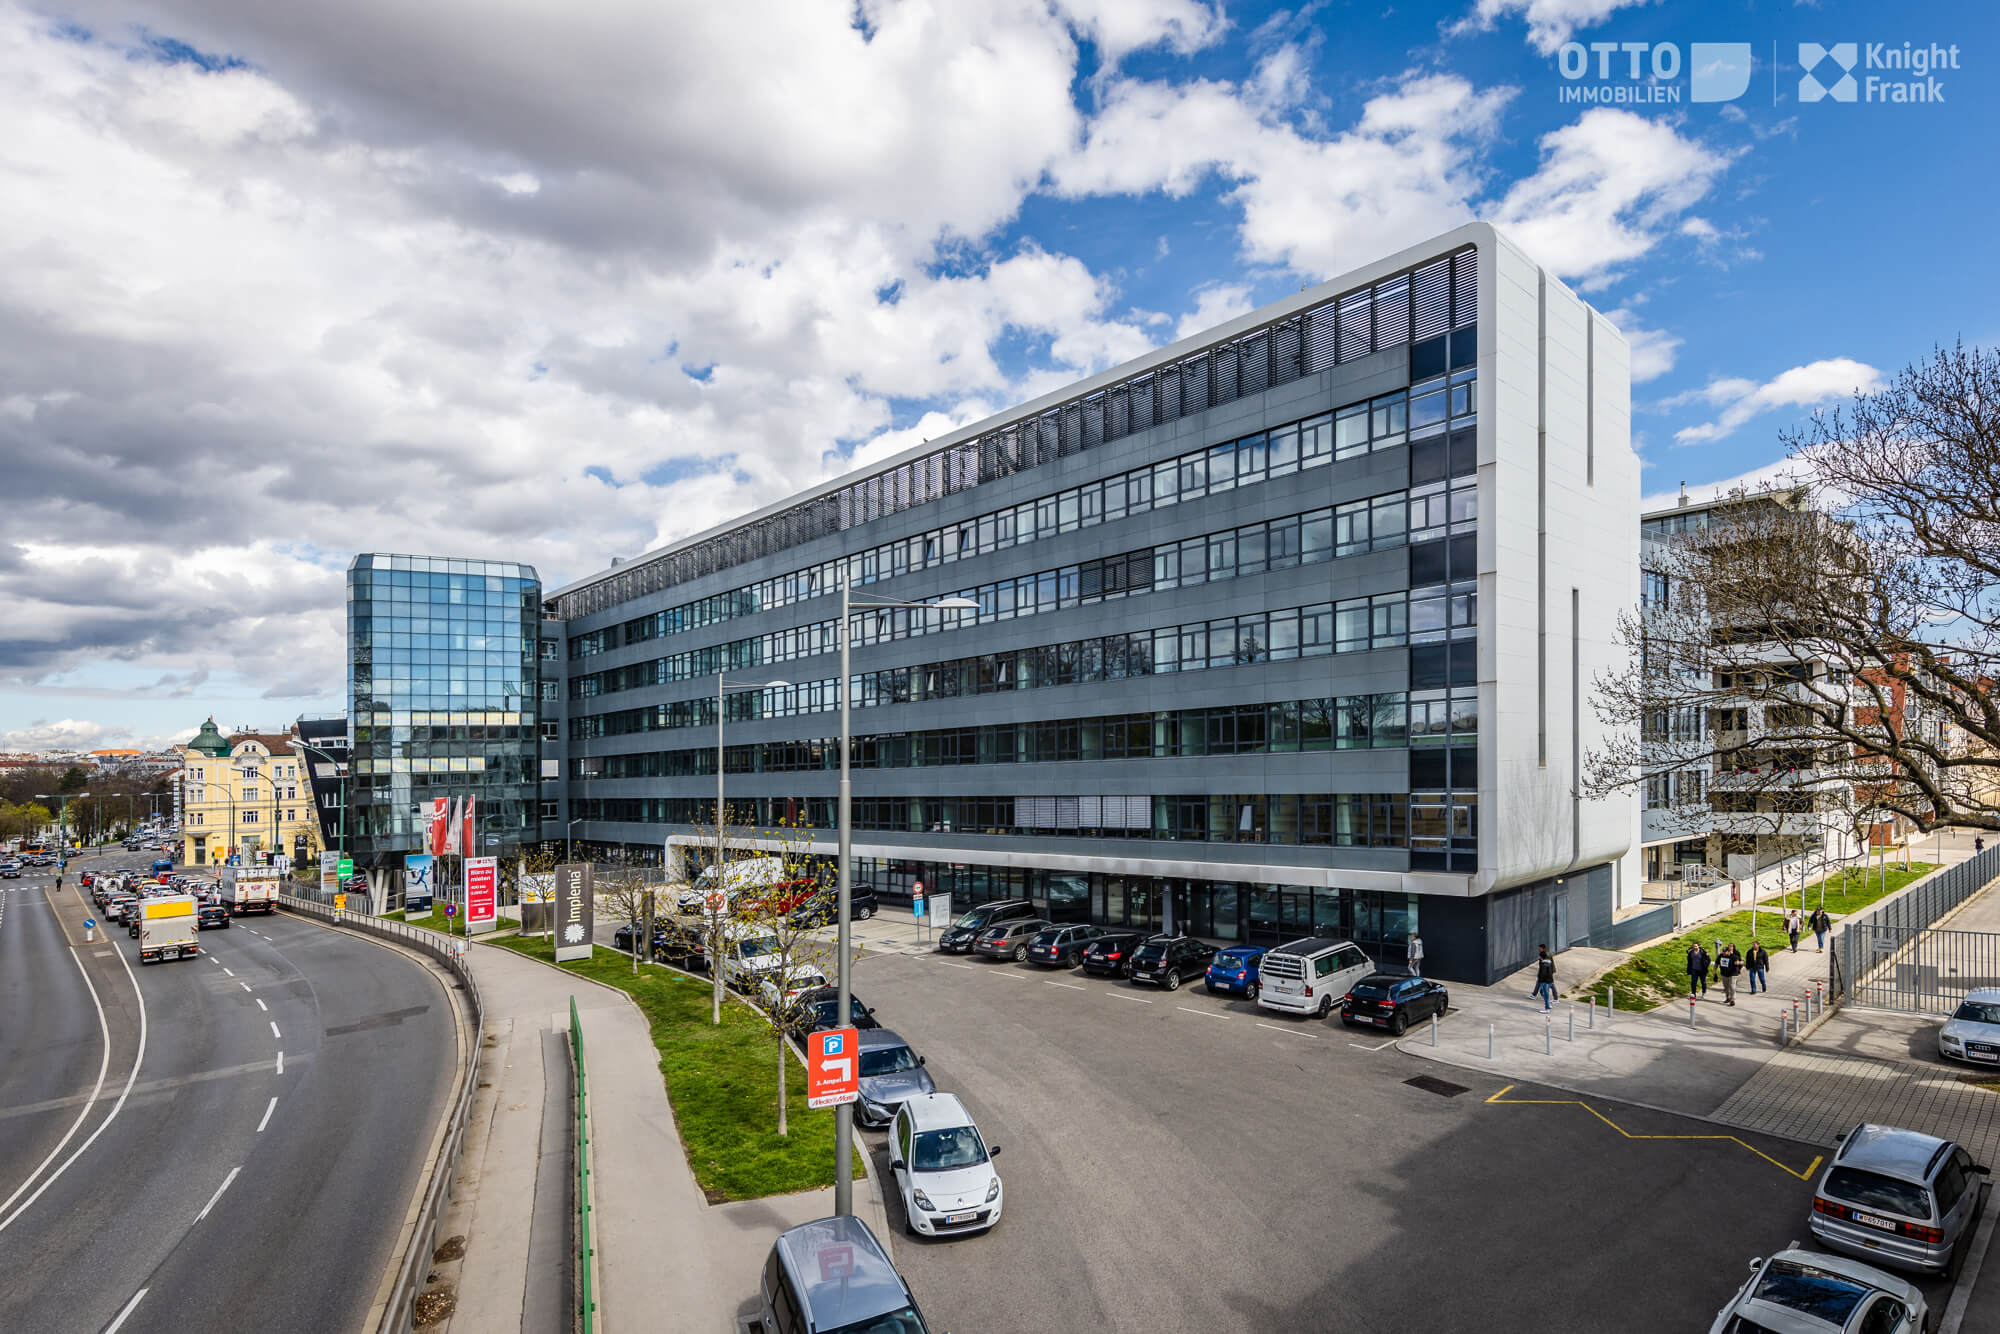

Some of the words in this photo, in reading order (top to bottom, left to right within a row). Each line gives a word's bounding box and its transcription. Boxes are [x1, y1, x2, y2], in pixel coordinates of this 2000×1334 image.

[566, 871, 585, 923] Implenia
[828, 1041, 839, 1053] P
[823, 1076, 842, 1085] Ampel
